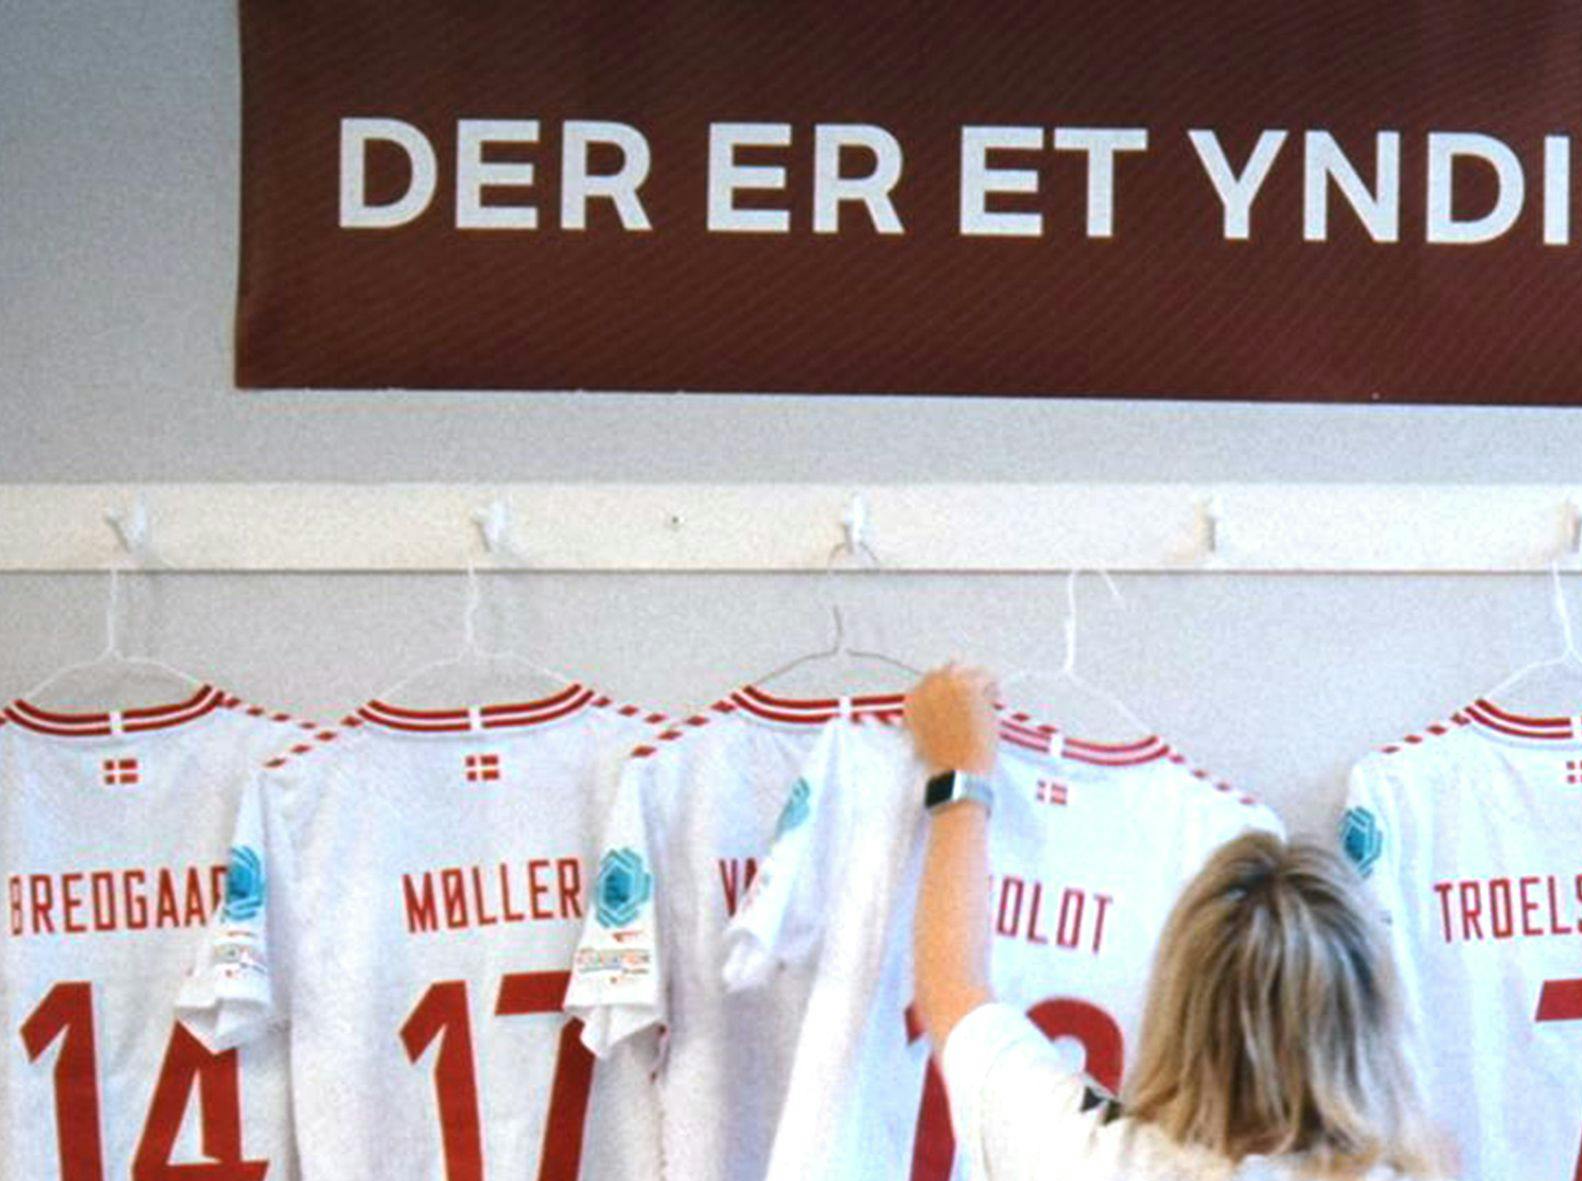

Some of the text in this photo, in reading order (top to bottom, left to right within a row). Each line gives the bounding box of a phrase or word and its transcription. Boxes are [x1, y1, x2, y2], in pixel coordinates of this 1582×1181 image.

[339, 117, 653, 232] DER
[707, 122, 904, 235] ER
[959, 125, 1148, 238] ET
[402, 858, 583, 933] MØLLER
[988, 875, 1113, 954] OLDT
